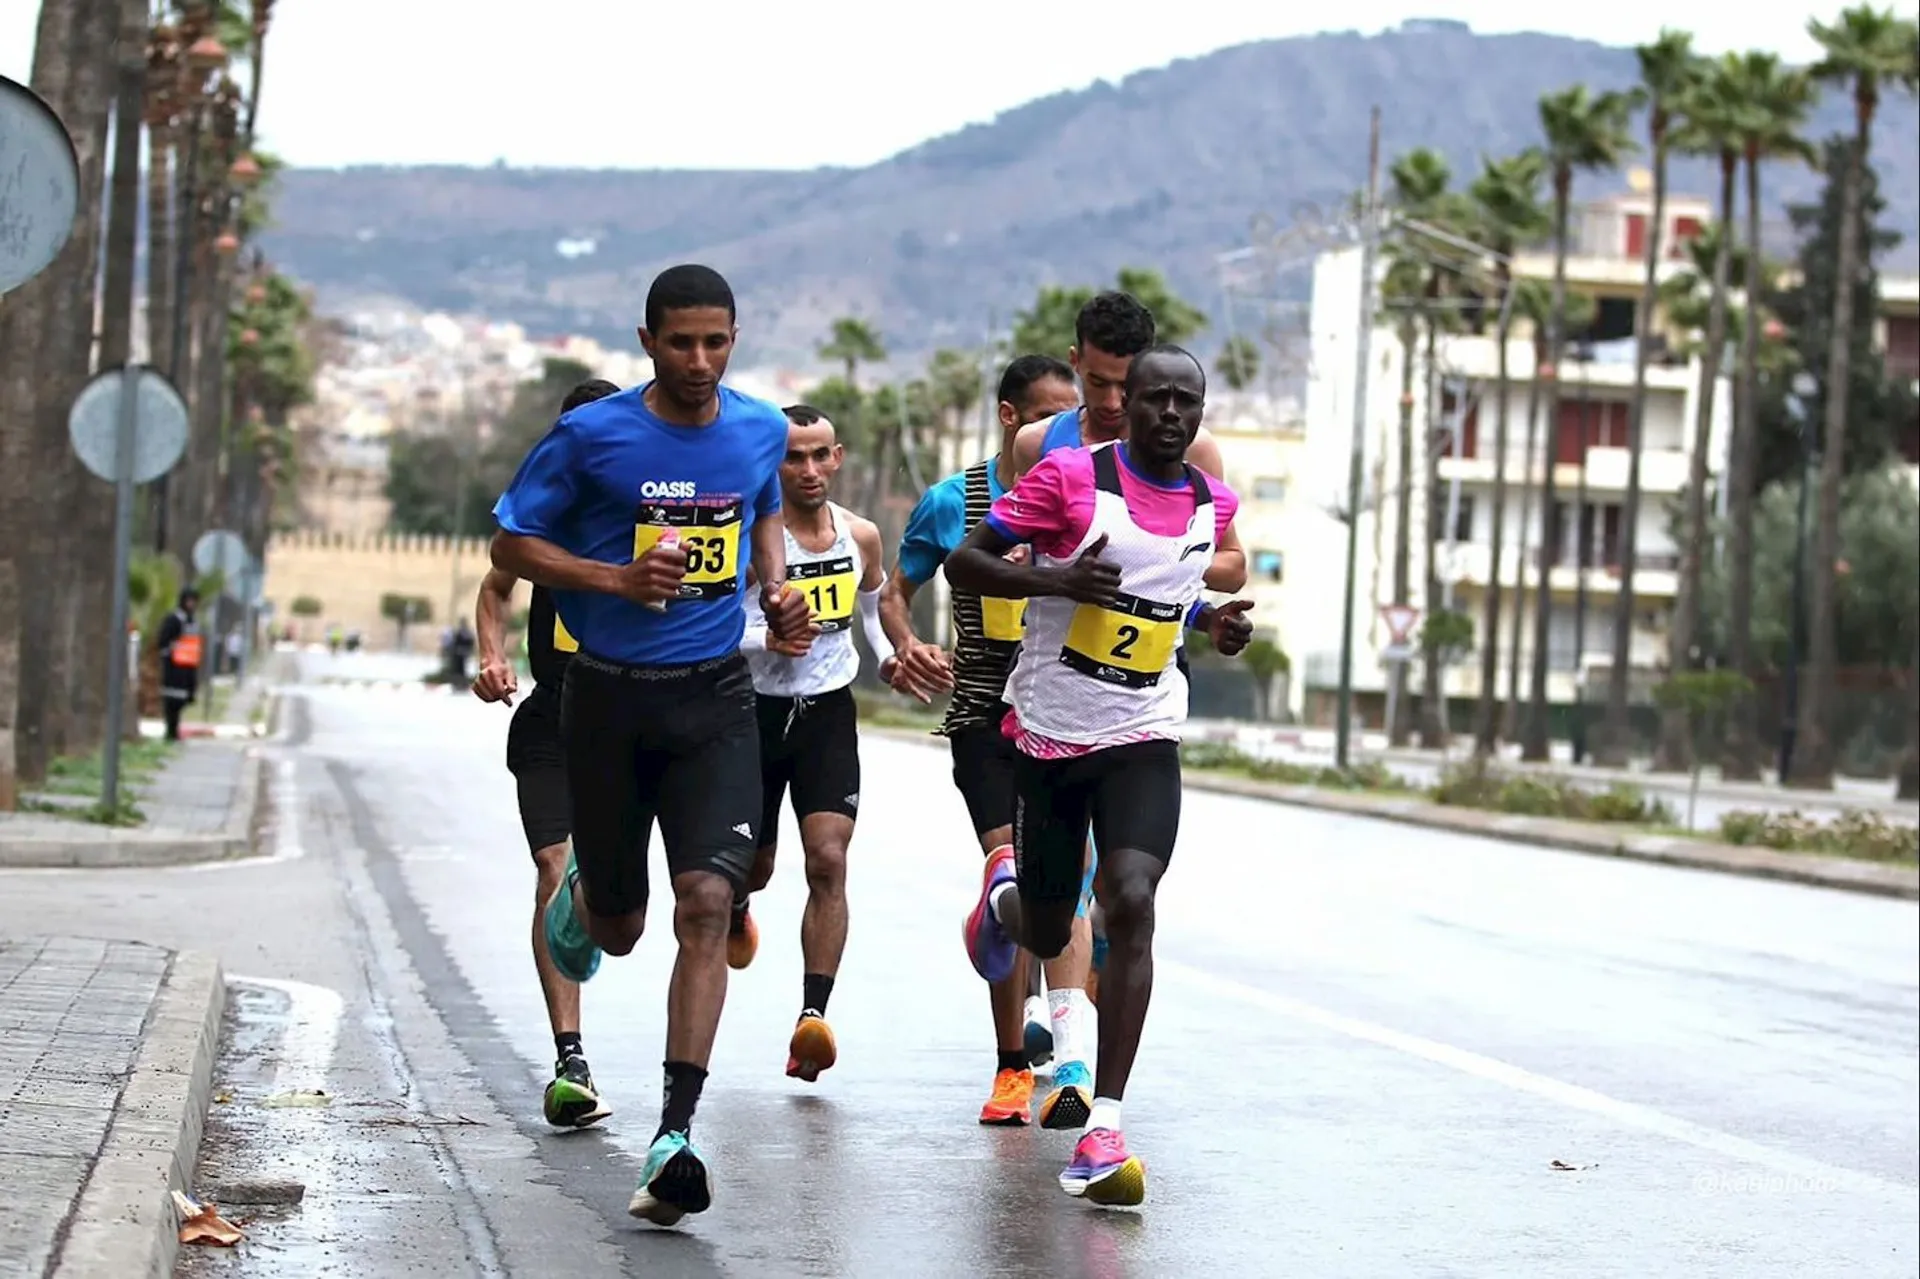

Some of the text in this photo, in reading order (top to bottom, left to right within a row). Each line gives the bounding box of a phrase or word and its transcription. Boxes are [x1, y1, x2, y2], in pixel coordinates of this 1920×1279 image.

[641, 481, 696, 498] OASIS
[810, 583, 839, 612] 11
[1110, 625, 1139, 660] 2
[631, 667, 692, 681] adipower
